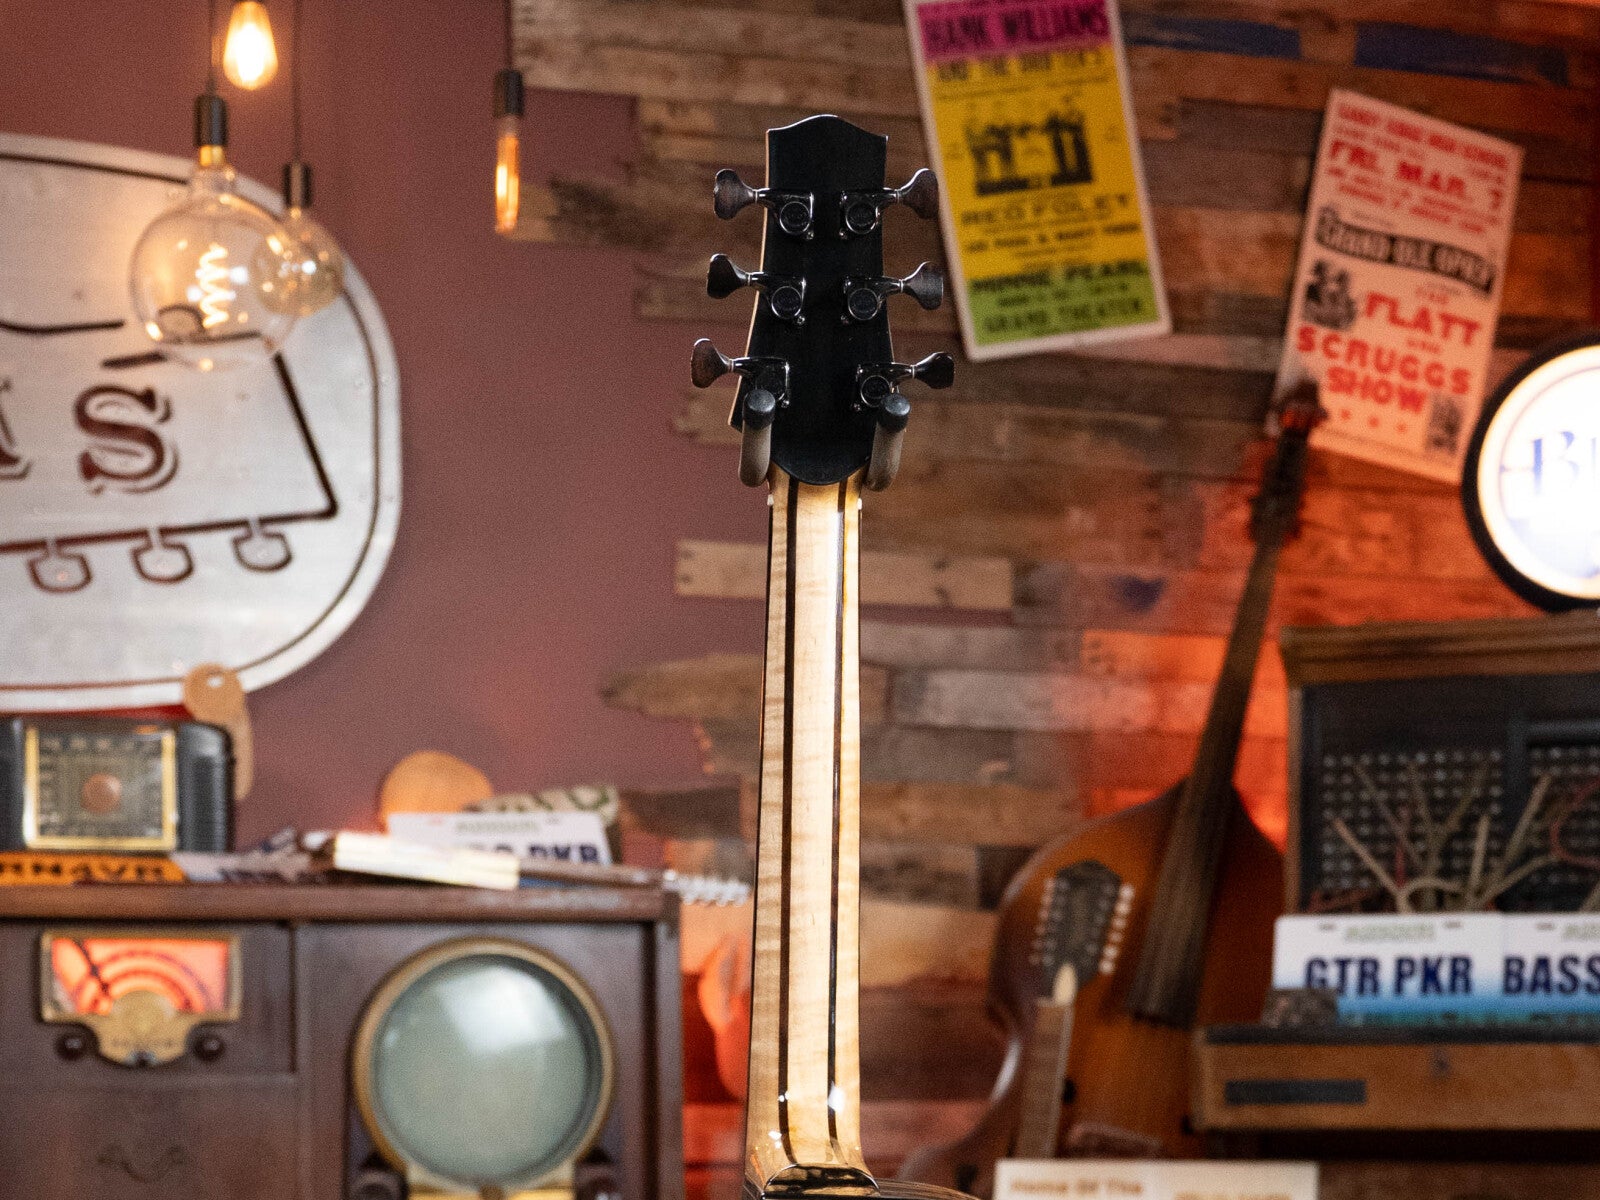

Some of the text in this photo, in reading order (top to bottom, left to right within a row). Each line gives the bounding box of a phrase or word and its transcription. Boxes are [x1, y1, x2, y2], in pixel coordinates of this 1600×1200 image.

[1364, 291, 1483, 348] FLATT
[1296, 325, 1473, 396] SCRUGGS
[1327, 365, 1429, 415] SHOW
[0, 380, 178, 493] S
[1304, 953, 1600, 997] GTR PKR BASS
